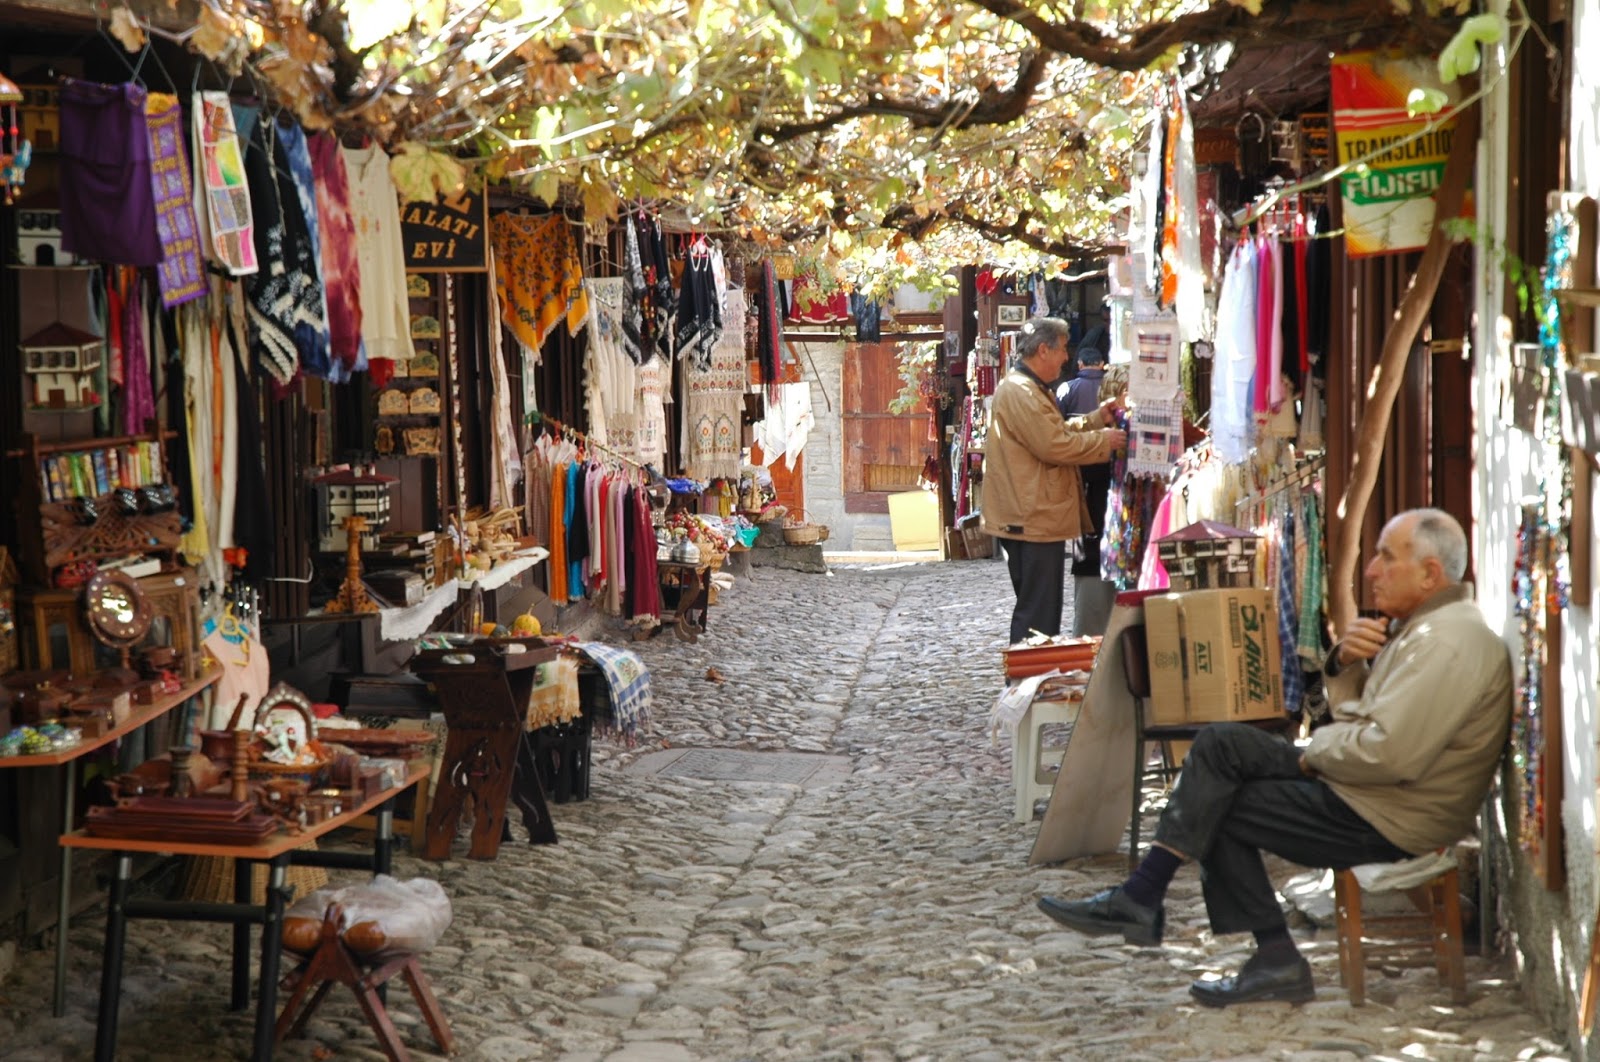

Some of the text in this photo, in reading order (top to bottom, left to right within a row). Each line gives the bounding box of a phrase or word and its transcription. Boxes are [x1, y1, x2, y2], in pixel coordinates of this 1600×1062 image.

[1344, 128, 1454, 164] TRANSLATIO
[1346, 168, 1441, 200] FUJIFIL
[412, 238, 456, 259] EVİ
[1196, 642, 1209, 673] ALT
[1243, 631, 1266, 703] ARIEL
